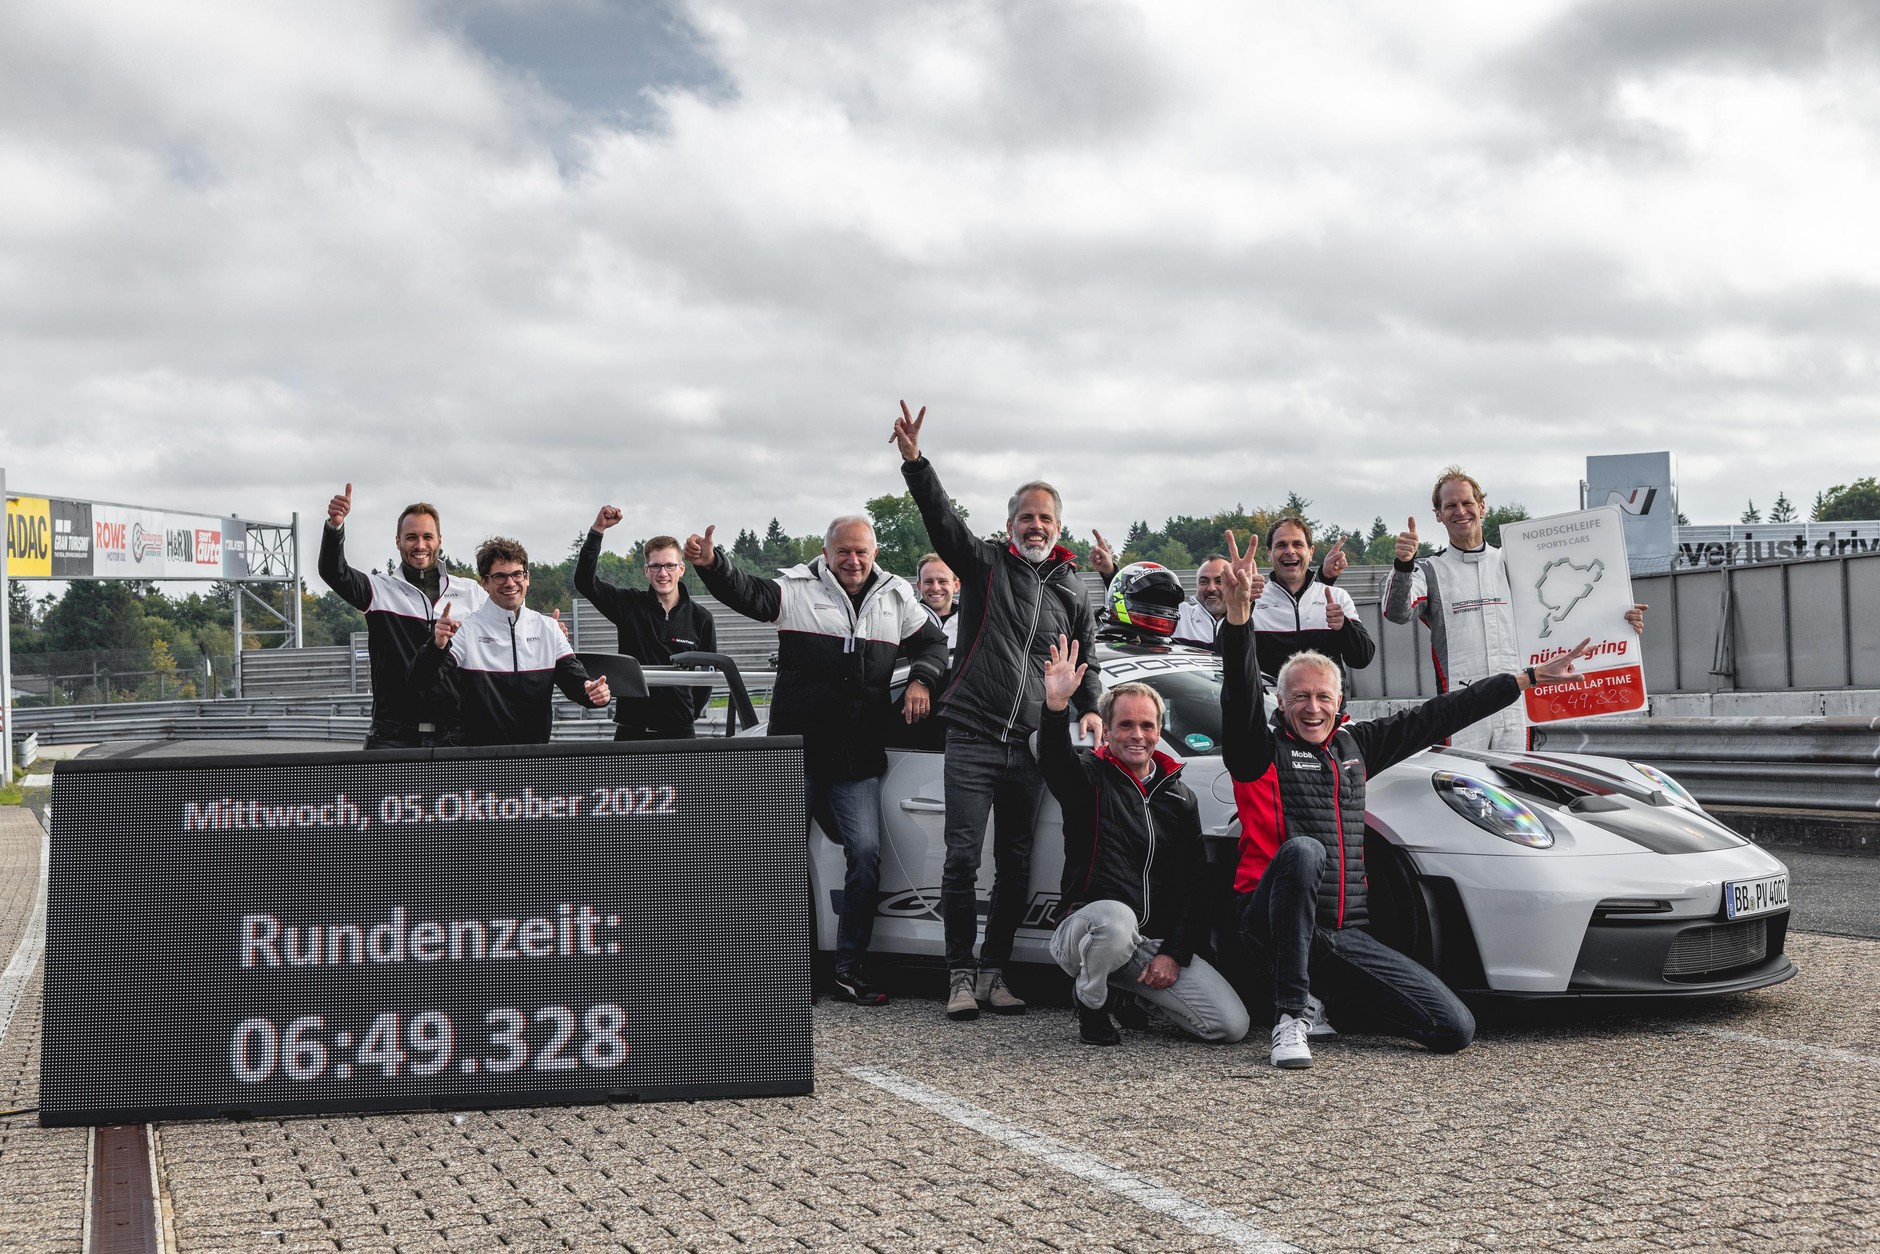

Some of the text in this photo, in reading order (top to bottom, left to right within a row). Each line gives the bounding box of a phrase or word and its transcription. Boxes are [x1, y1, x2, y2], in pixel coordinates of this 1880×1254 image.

[7, 513, 48, 560] ADAC
[96, 521, 126, 550] ROWE
[1522, 518, 1602, 541] NORDSCHLEIFE
[1536, 535, 1591, 551] SPORTS CARS
[197, 541, 221, 563] auto
[1534, 674, 1632, 697] OFFICIAL LAP TIME
[183, 784, 678, 831] Mittwoch, 05.Oktober 2022
[1734, 878, 1787, 913] BB PV 4002
[240, 903, 620, 968] Rundenzeit:
[230, 1003, 629, 1084] 06:49.328
